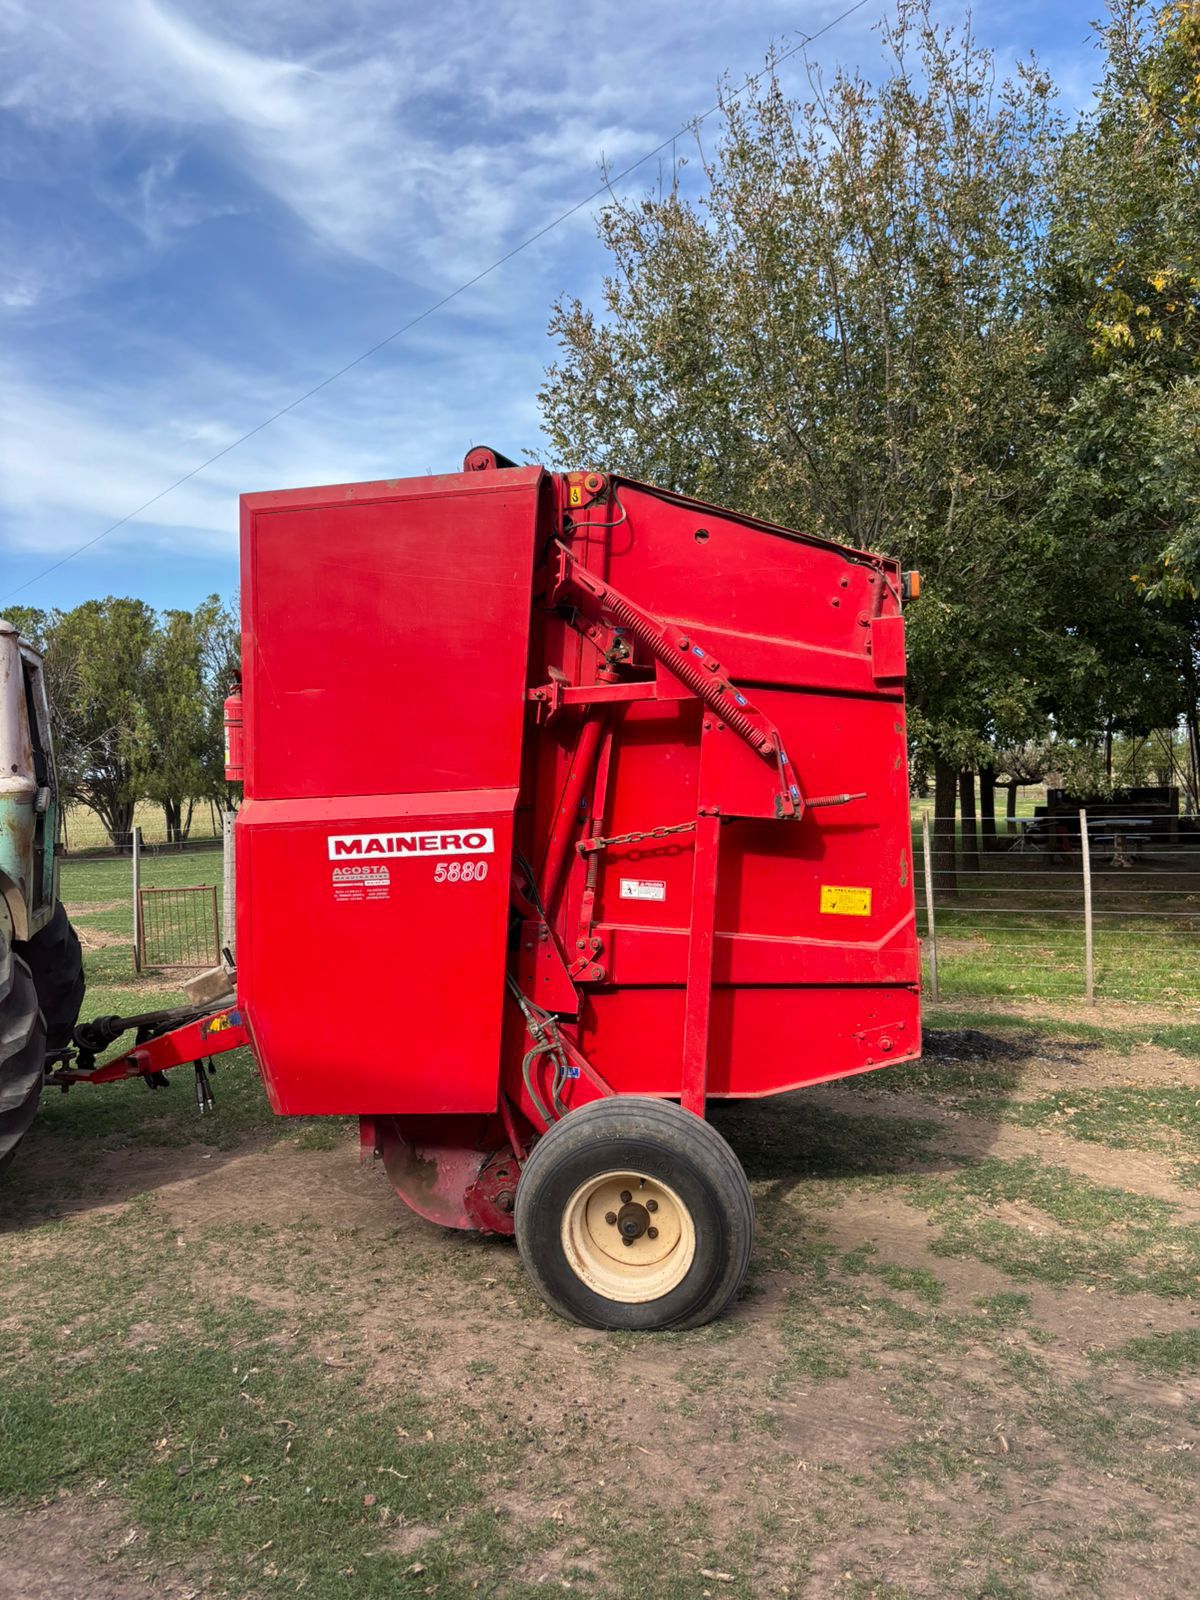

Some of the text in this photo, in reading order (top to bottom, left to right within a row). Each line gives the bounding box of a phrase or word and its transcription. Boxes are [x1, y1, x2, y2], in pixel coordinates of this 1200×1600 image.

[334, 833, 487, 855] MAINERO
[332, 865, 389, 875] ACOSTA
[433, 861, 488, 883] 5880
